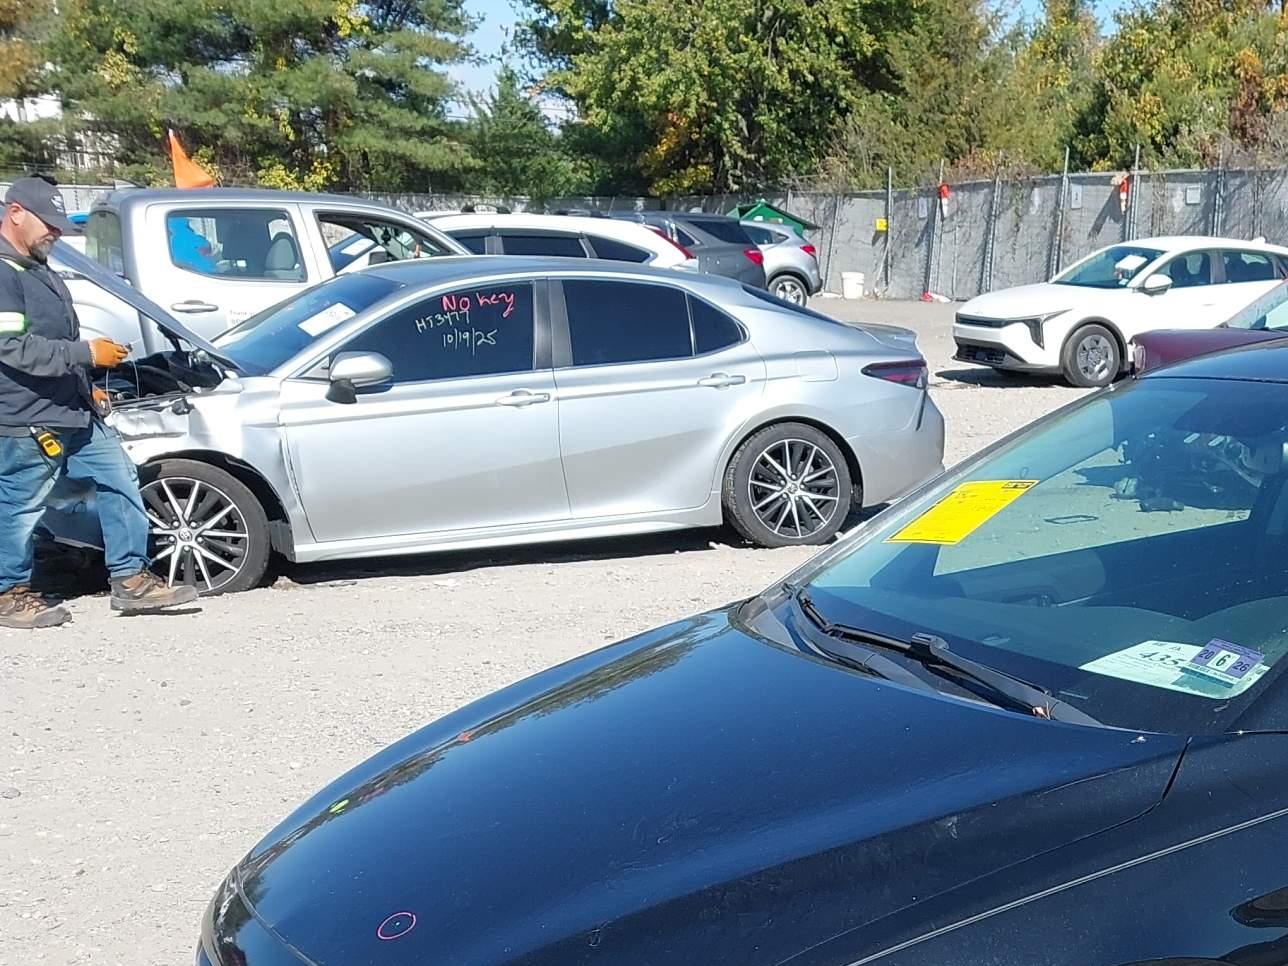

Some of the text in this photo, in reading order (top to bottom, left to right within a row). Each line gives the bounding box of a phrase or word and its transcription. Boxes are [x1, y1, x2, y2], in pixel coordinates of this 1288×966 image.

[441, 295, 470, 311] No
[442, 327, 498, 356] 10/19/25
[1199, 649, 1215, 660] 20
[1215, 654, 1231, 667] 6
[1232, 661, 1249, 672] 26
